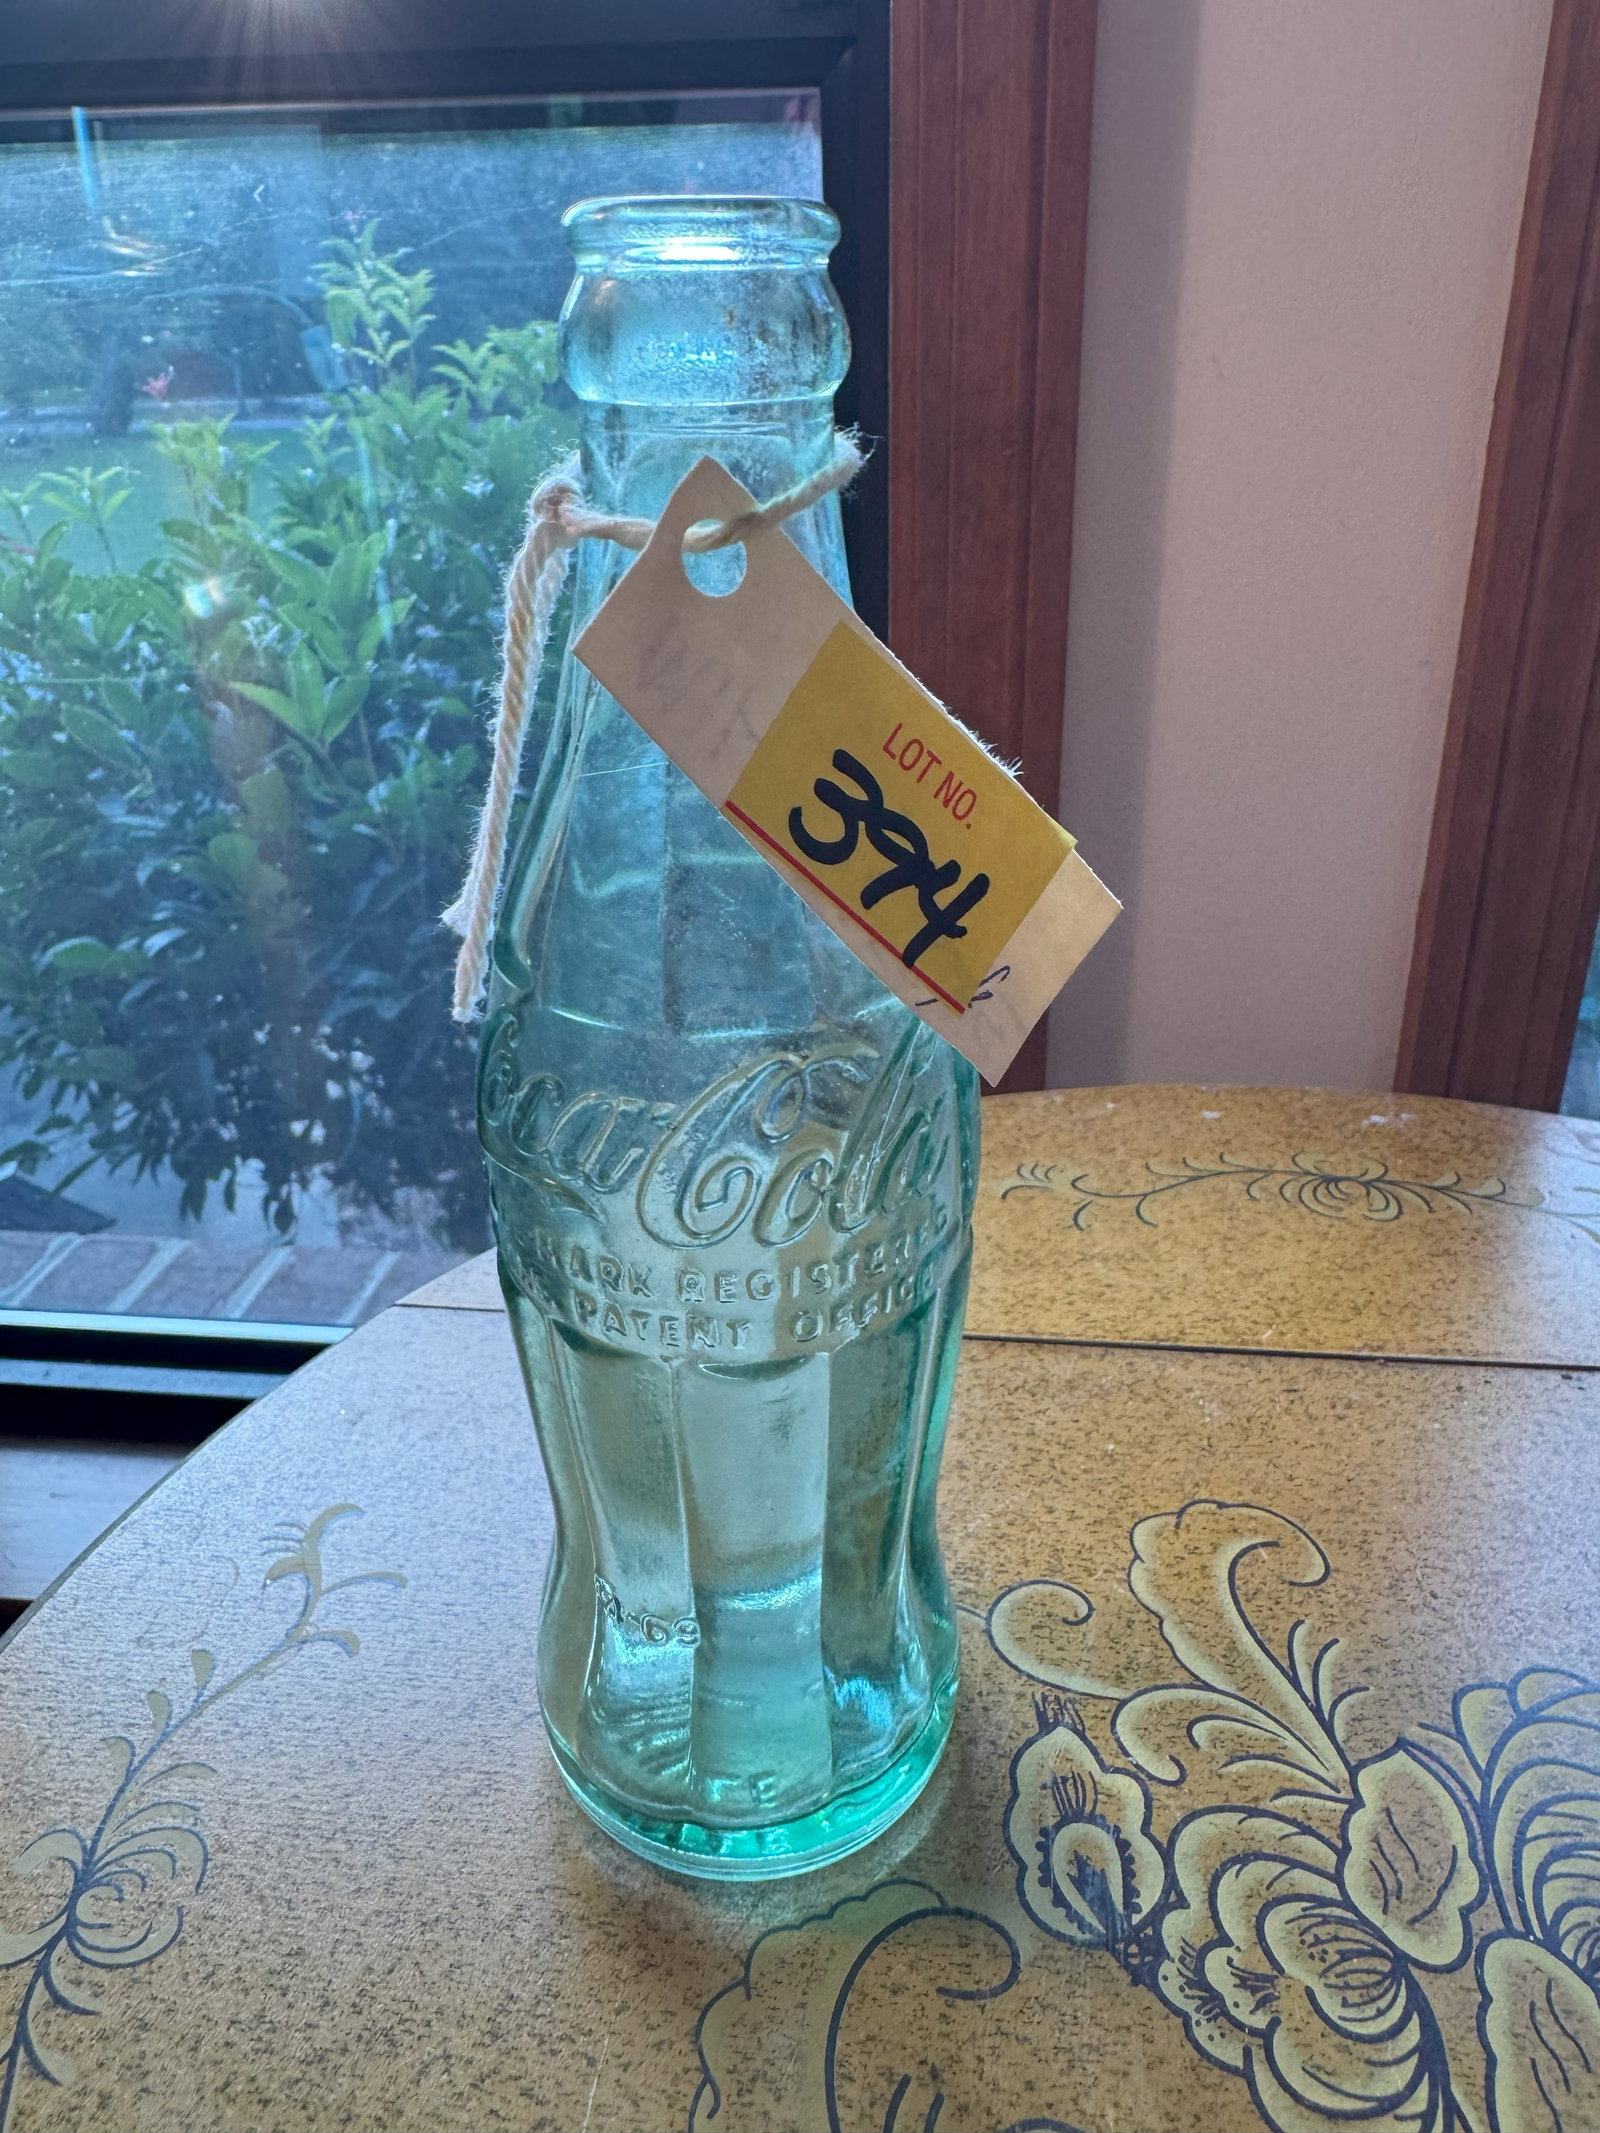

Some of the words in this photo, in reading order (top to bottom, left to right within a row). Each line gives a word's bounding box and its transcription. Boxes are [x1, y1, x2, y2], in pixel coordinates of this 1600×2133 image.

[882, 722, 942, 783] LOT
[933, 770, 977, 830] NO.
[788, 748, 991, 968] 394
[572, 1288, 752, 1349] PATENT
